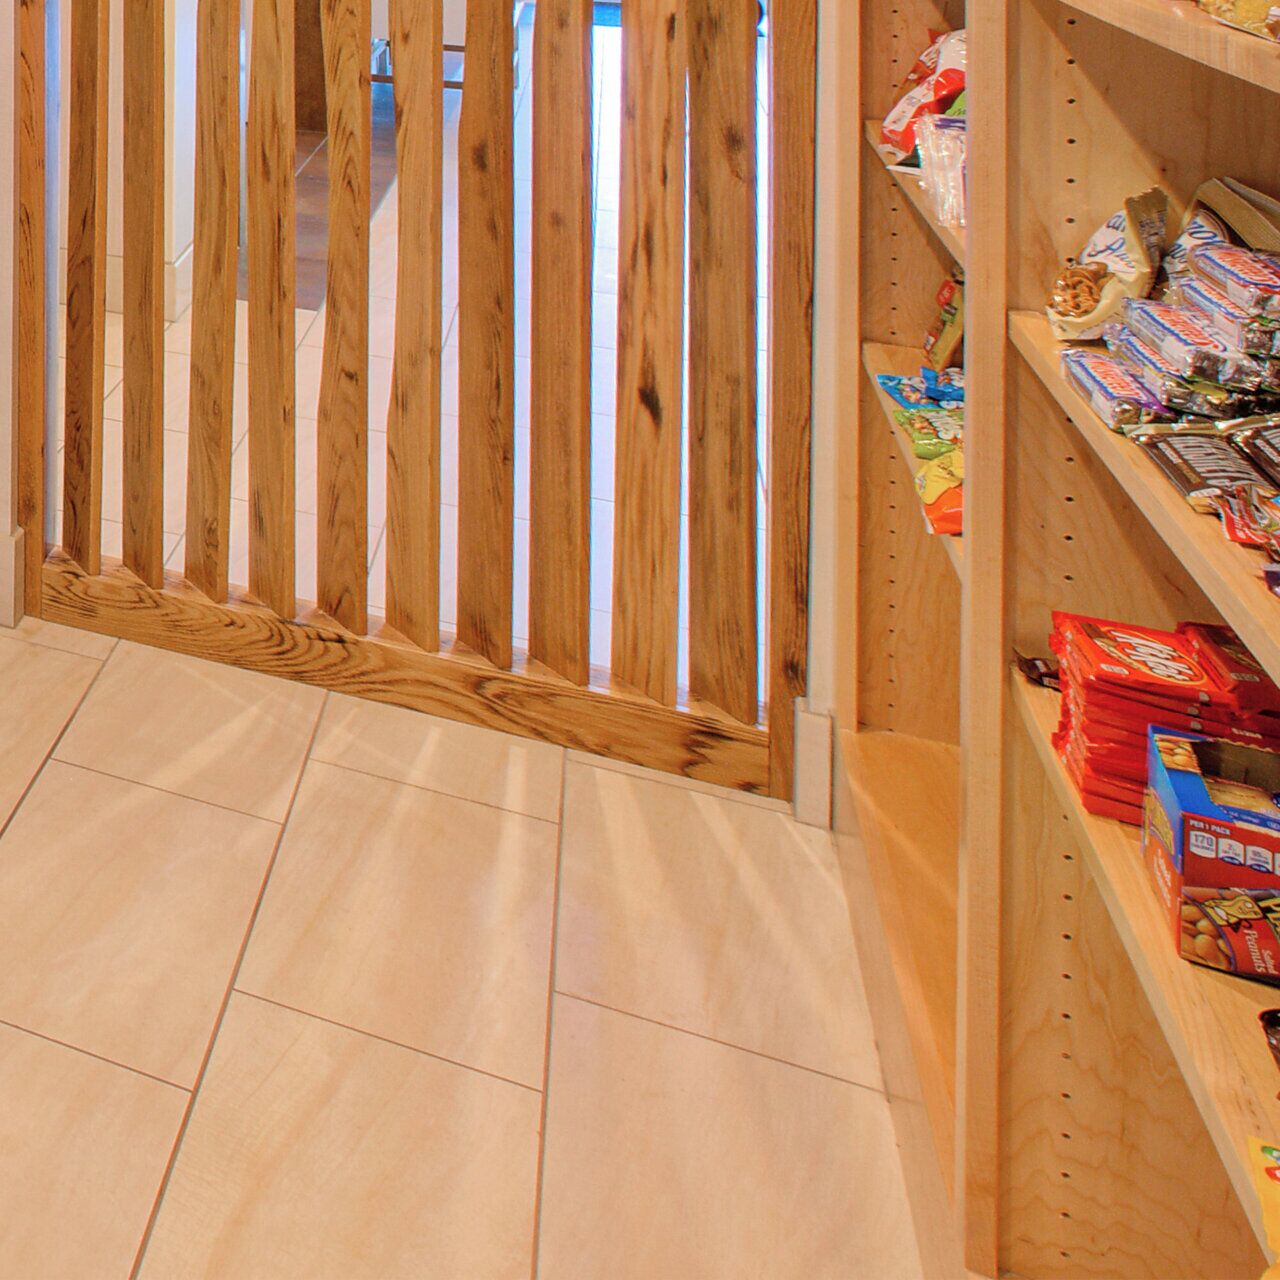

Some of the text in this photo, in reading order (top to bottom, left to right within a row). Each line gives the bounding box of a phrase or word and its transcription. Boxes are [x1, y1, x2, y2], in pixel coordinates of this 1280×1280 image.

[1190, 819, 1206, 829] PER
[1211, 824, 1231, 835] PACK
[1243, 929, 1266, 974] Peanuts
